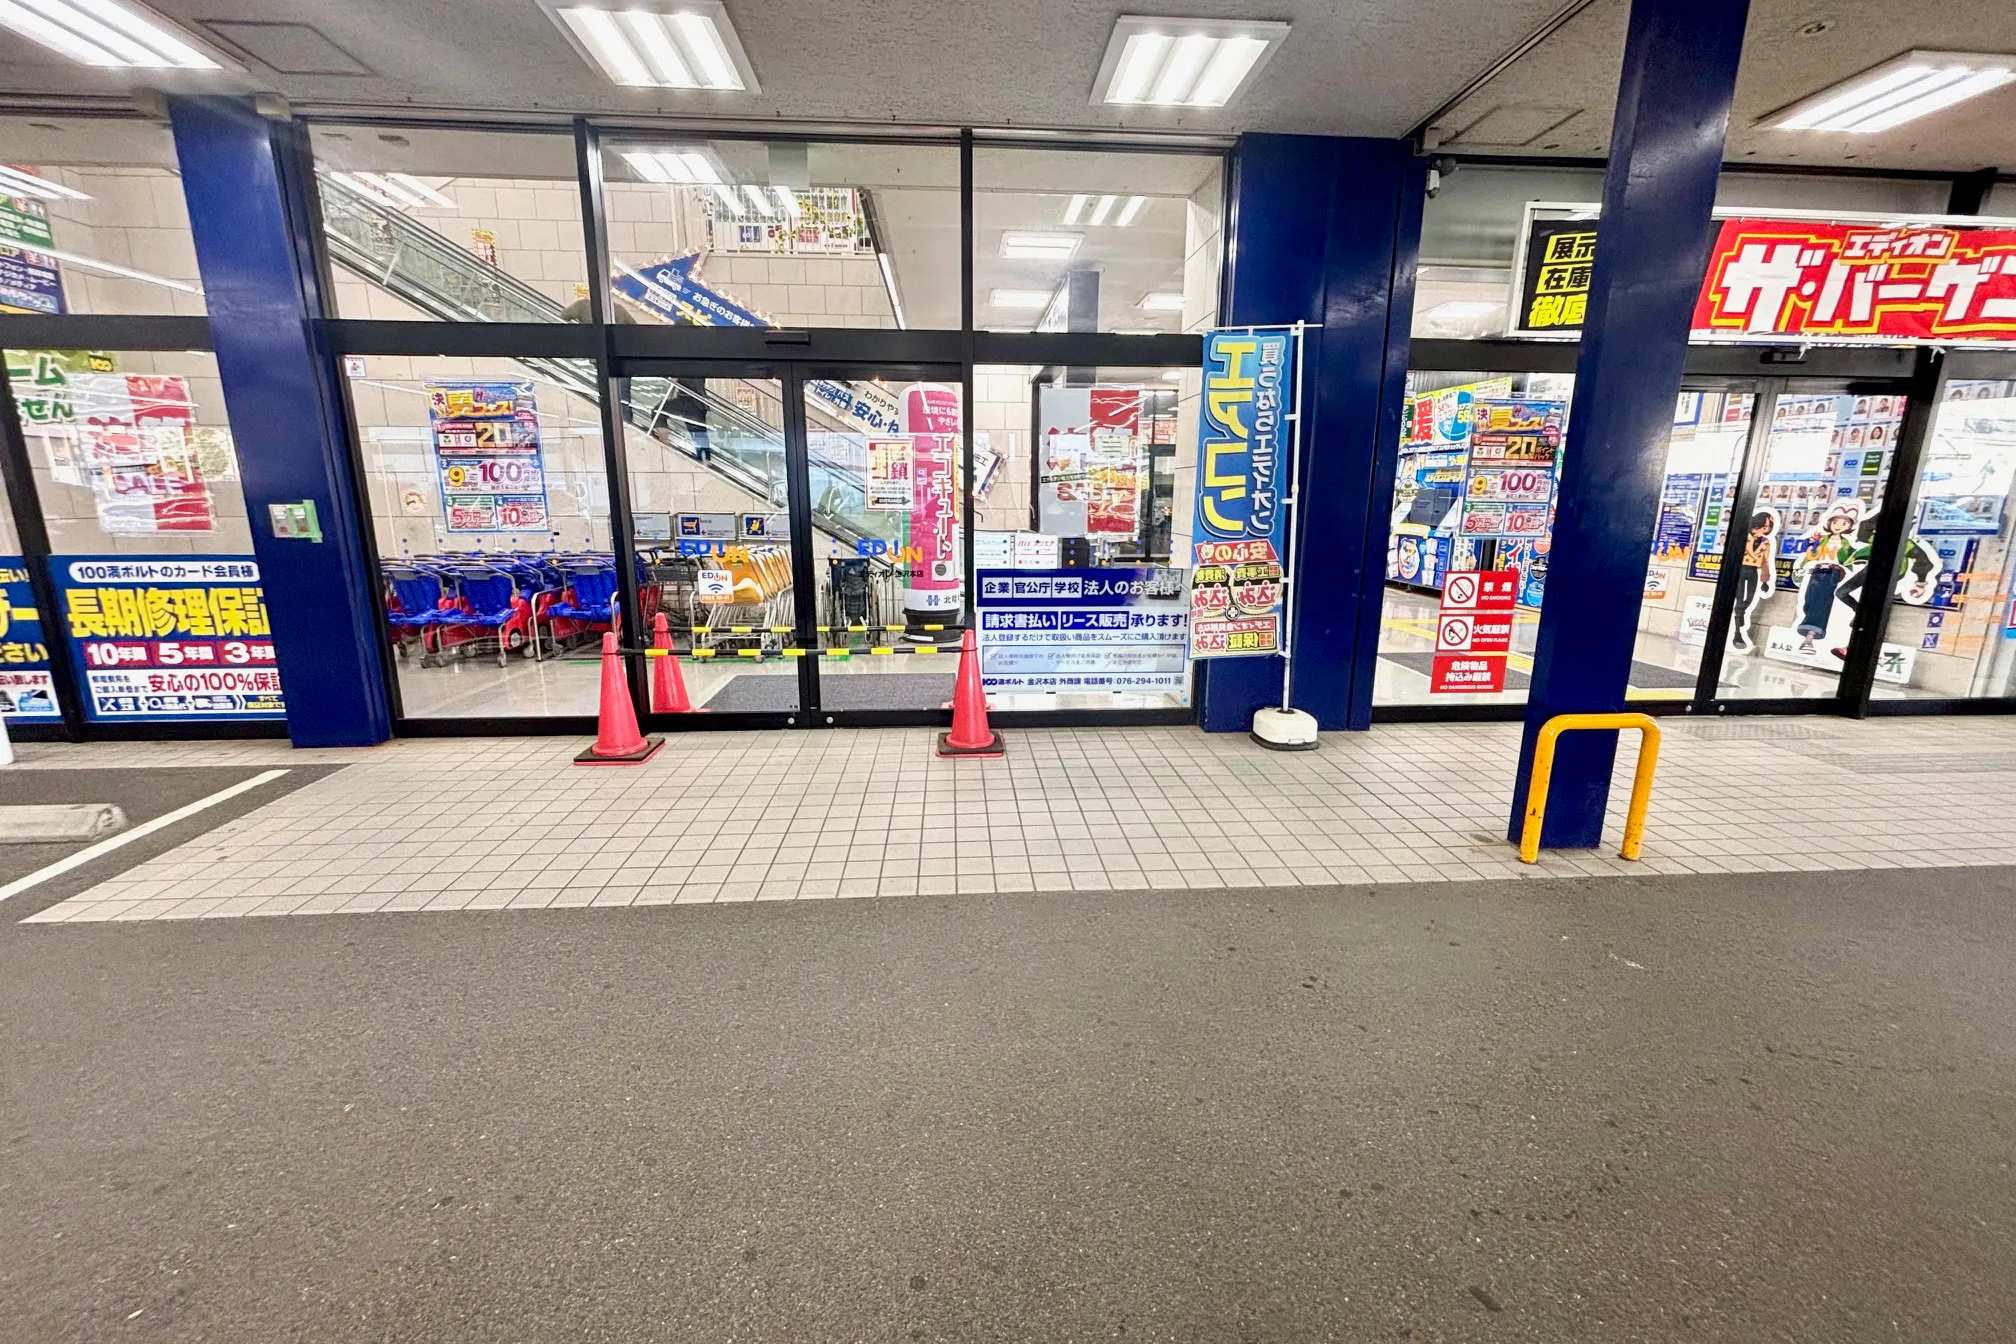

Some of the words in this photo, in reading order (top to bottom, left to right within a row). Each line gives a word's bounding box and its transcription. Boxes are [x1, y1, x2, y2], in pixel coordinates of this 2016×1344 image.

[1550, 232, 1596, 260] 展示
[1844, 232, 1951, 257] エディオン
[1543, 267, 1591, 290] 在庫
[692, 292, 755, 326] お急ぎのお客様
[1528, 294, 1587, 327] 徹底
[479, 462, 523, 484] 100
[1501, 472, 1537, 492] 100
[932, 432, 954, 558] エコキュート
[1474, 475, 1488, 495] 9
[680, 539, 748, 563] EDION
[857, 538, 923, 563] EDION
[77, 565, 254, 580] 100満ボルトのカード会員様
[702, 572, 727, 581] EDION
[984, 581, 1010, 595] 企業
[1014, 581, 1051, 595] 官公庁
[1054, 581, 1079, 595] 学校
[1083, 580, 1189, 596] 法人のお客様へ
[66, 587, 271, 638] 長期修理保証
[985, 613, 1057, 629] 請求書払い
[1062, 613, 1129, 629] リース販売
[1130, 613, 1188, 628] 承ります!
[982, 633, 1187, 642] 法人登録するだけで取扱い商品をスムーズにご購入頂けます
[1771, 642, 1793, 652] 主人公
[87, 642, 148, 666] 10年間
[159, 642, 214, 665] 5年間
[1027, 678, 1057, 686] 金沢本店
[1059, 678, 1081, 686] 外商課
